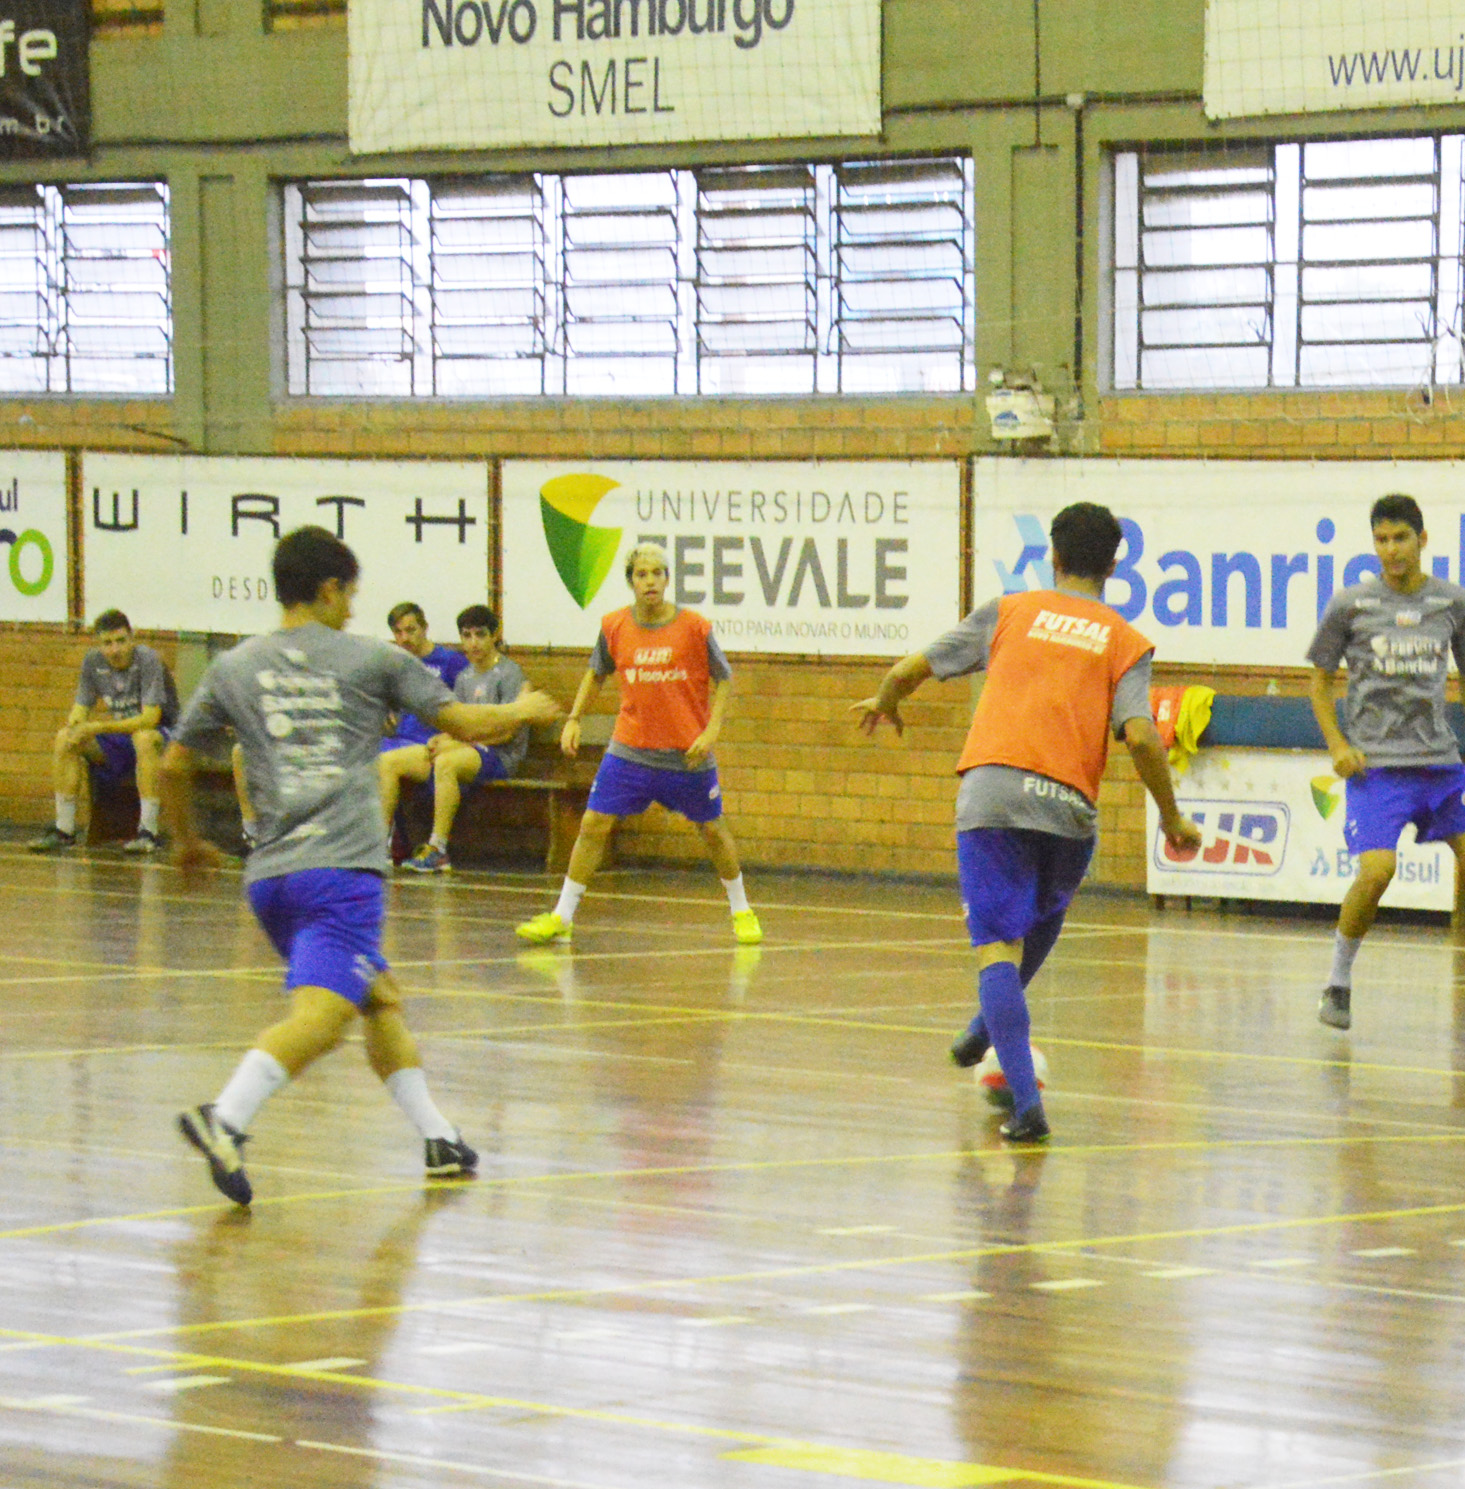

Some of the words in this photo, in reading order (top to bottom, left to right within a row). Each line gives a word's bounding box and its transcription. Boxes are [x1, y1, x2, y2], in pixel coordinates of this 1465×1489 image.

[421, 0, 537, 48] Novo
[553, 0, 794, 49] Hamburgo
[548, 57, 675, 117] SMEL
[93, 487, 477, 544] WIRTH
[637, 490, 910, 523] UNIVERSIDADE
[211, 575, 269, 601] DESD
[746, 620, 783, 638] PARA
[786, 622, 838, 640] INOVAR
[854, 624, 910, 641] MUNDO
[1032, 609, 1111, 644] FUTSAL
